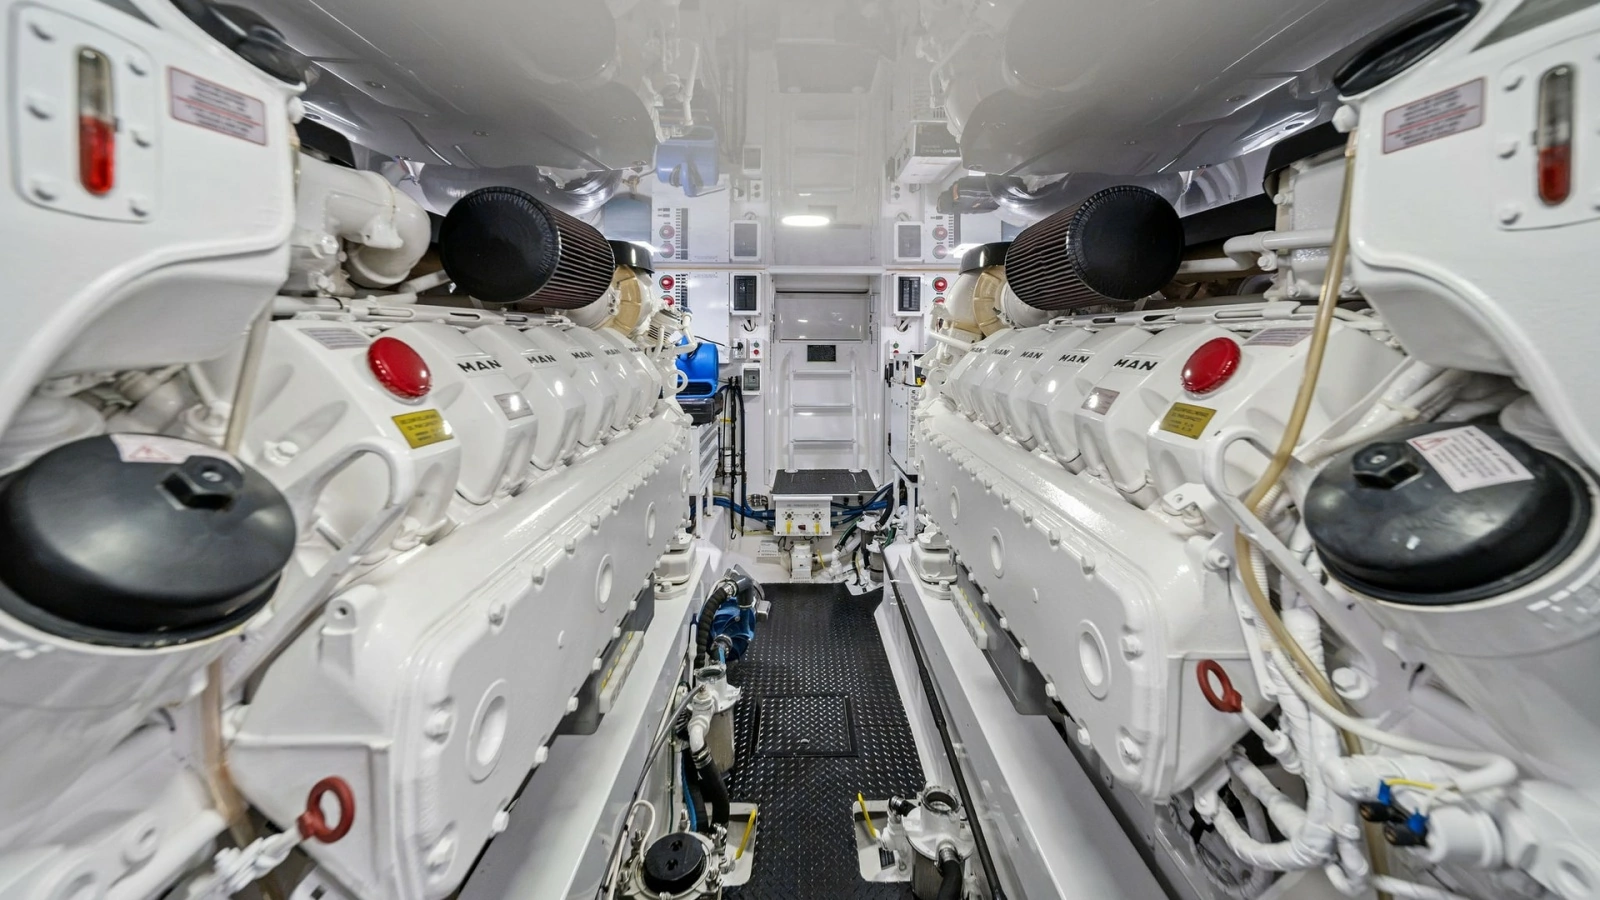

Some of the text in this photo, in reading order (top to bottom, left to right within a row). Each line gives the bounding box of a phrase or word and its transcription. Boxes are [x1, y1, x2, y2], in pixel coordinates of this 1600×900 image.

[571, 351, 594, 359] MAN
[604, 348, 621, 356] MAN
[1020, 351, 1043, 359] MAN
[527, 354, 557, 364] MAN
[1058, 354, 1090, 364] MAN
[457, 359, 503, 373] MAN
[1113, 359, 1158, 371] MAN
